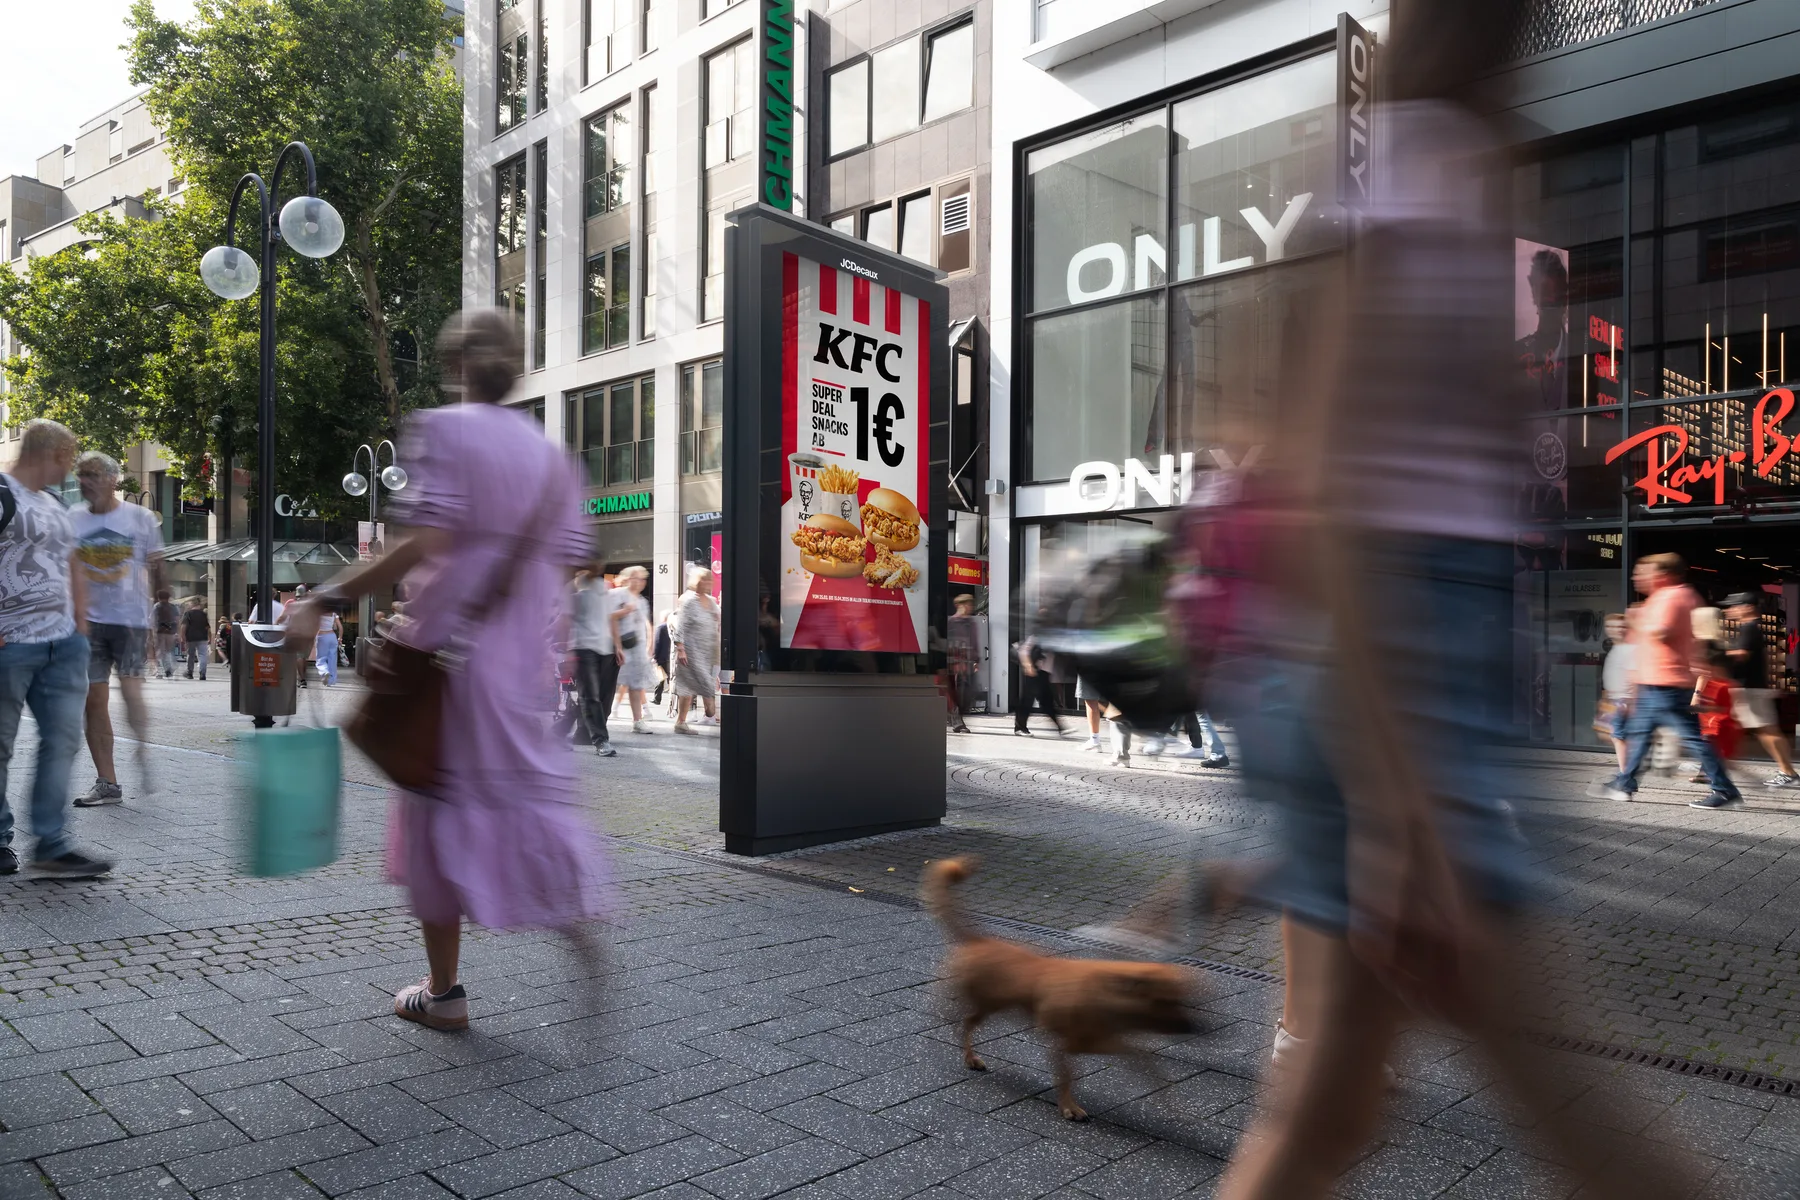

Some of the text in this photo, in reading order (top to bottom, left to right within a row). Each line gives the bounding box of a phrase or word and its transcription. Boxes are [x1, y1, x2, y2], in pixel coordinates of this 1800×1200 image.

[1350, 34, 1367, 199] ONLY
[1066, 192, 1314, 305] ONLY
[840, 258, 878, 280] JCDecaux
[813, 322, 903, 383] KFC
[812, 383, 843, 404] SUPER
[812, 399, 836, 418] DEAL
[812, 415, 849, 436] SNACKS
[850, 387, 905, 468] 1€
[812, 431, 825, 447] AB
[1605, 388, 1800, 507] Ray-B
[798, 511, 814, 521] KF
[658, 564, 668, 574] 56
[954, 563, 981, 578] Pommes
